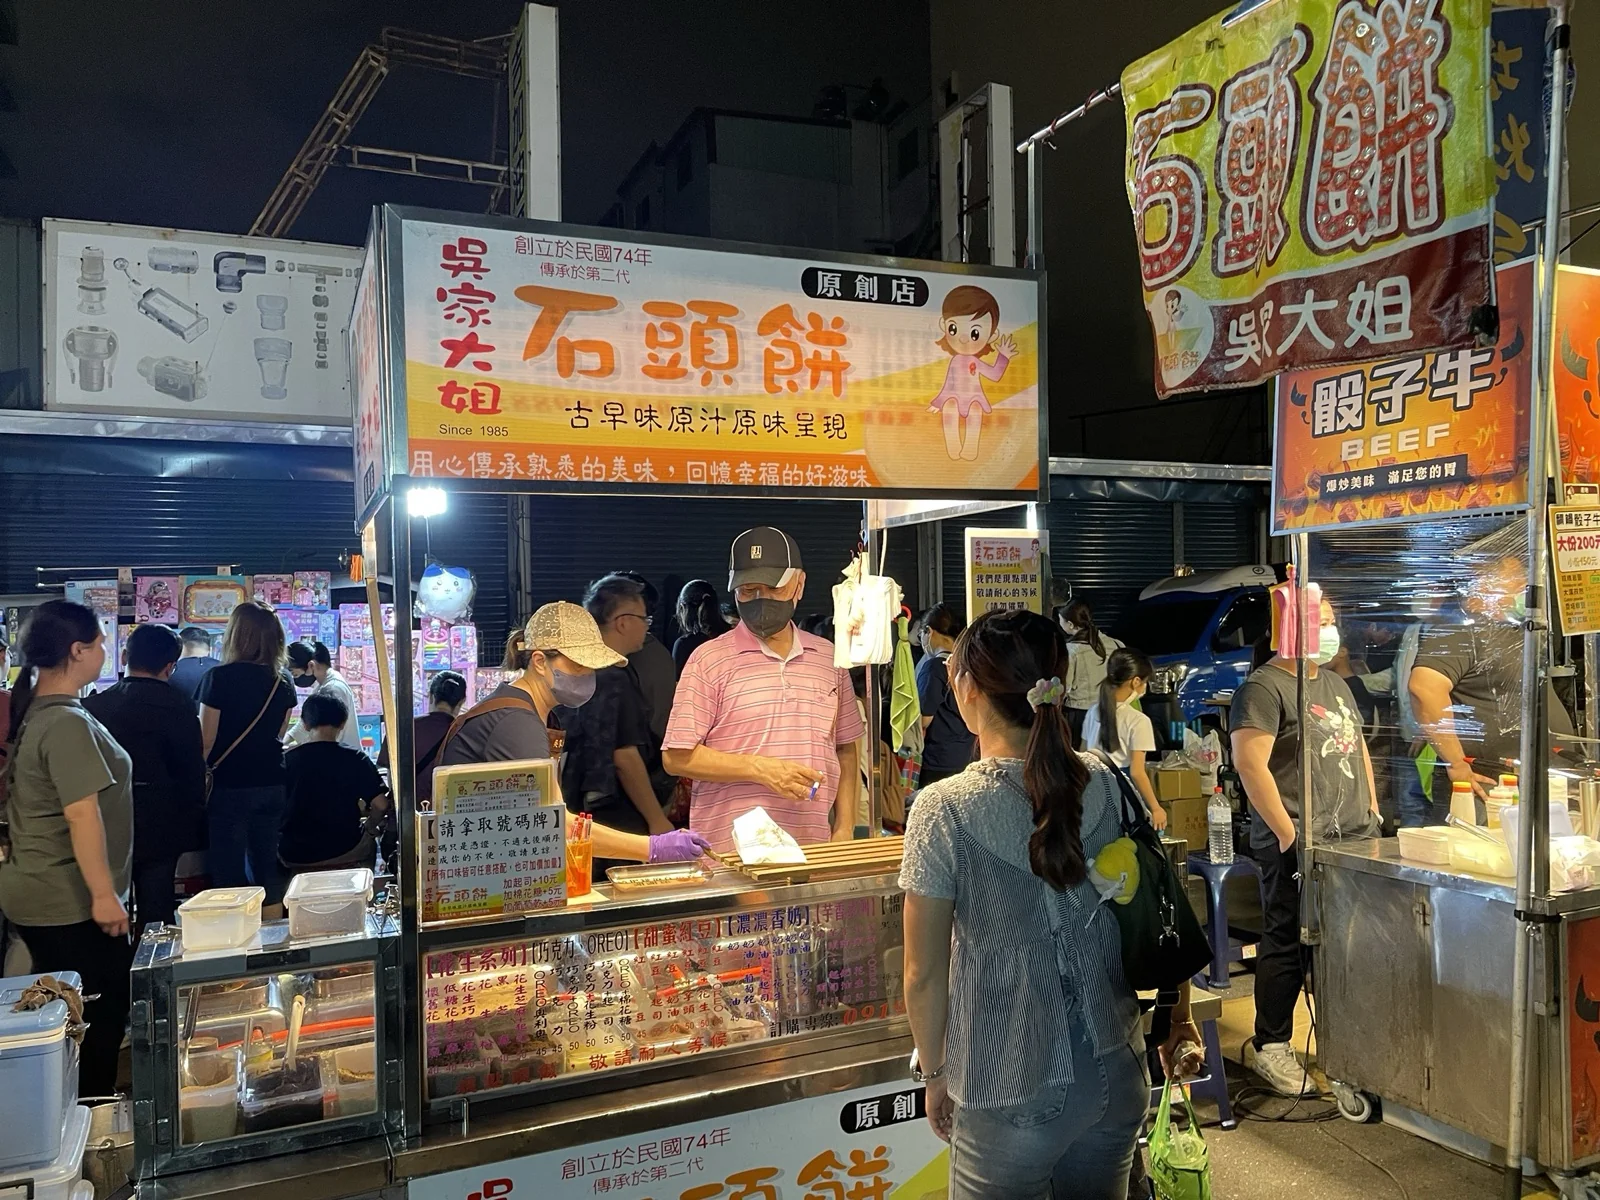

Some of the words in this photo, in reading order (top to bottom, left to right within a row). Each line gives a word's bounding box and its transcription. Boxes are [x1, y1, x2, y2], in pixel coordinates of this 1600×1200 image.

[513, 234, 654, 268] 創立於民國74年
[539, 260, 632, 286] 傳承於第二代
[815, 269, 917, 306] 原創店
[436, 237, 503, 417] 吳家大姐
[513, 284, 854, 399] 石頭餅
[1159, 350, 1201, 371] 頭餅
[1313, 347, 1495, 437] 骰子牛
[438, 423, 474, 437] Since
[479, 424, 510, 438] 1985
[564, 401, 848, 441] 古早味原汁原味呈現
[1341, 422, 1450, 462] BEEF
[1325, 474, 1376, 494] 爆炒美味
[1387, 460, 1457, 484] 滿足您的胃
[983, 546, 1022, 561] 石頭餅
[560, 1126, 732, 1181] 創立於民國74年
[592, 1156, 705, 1196] 傳承於第二代
